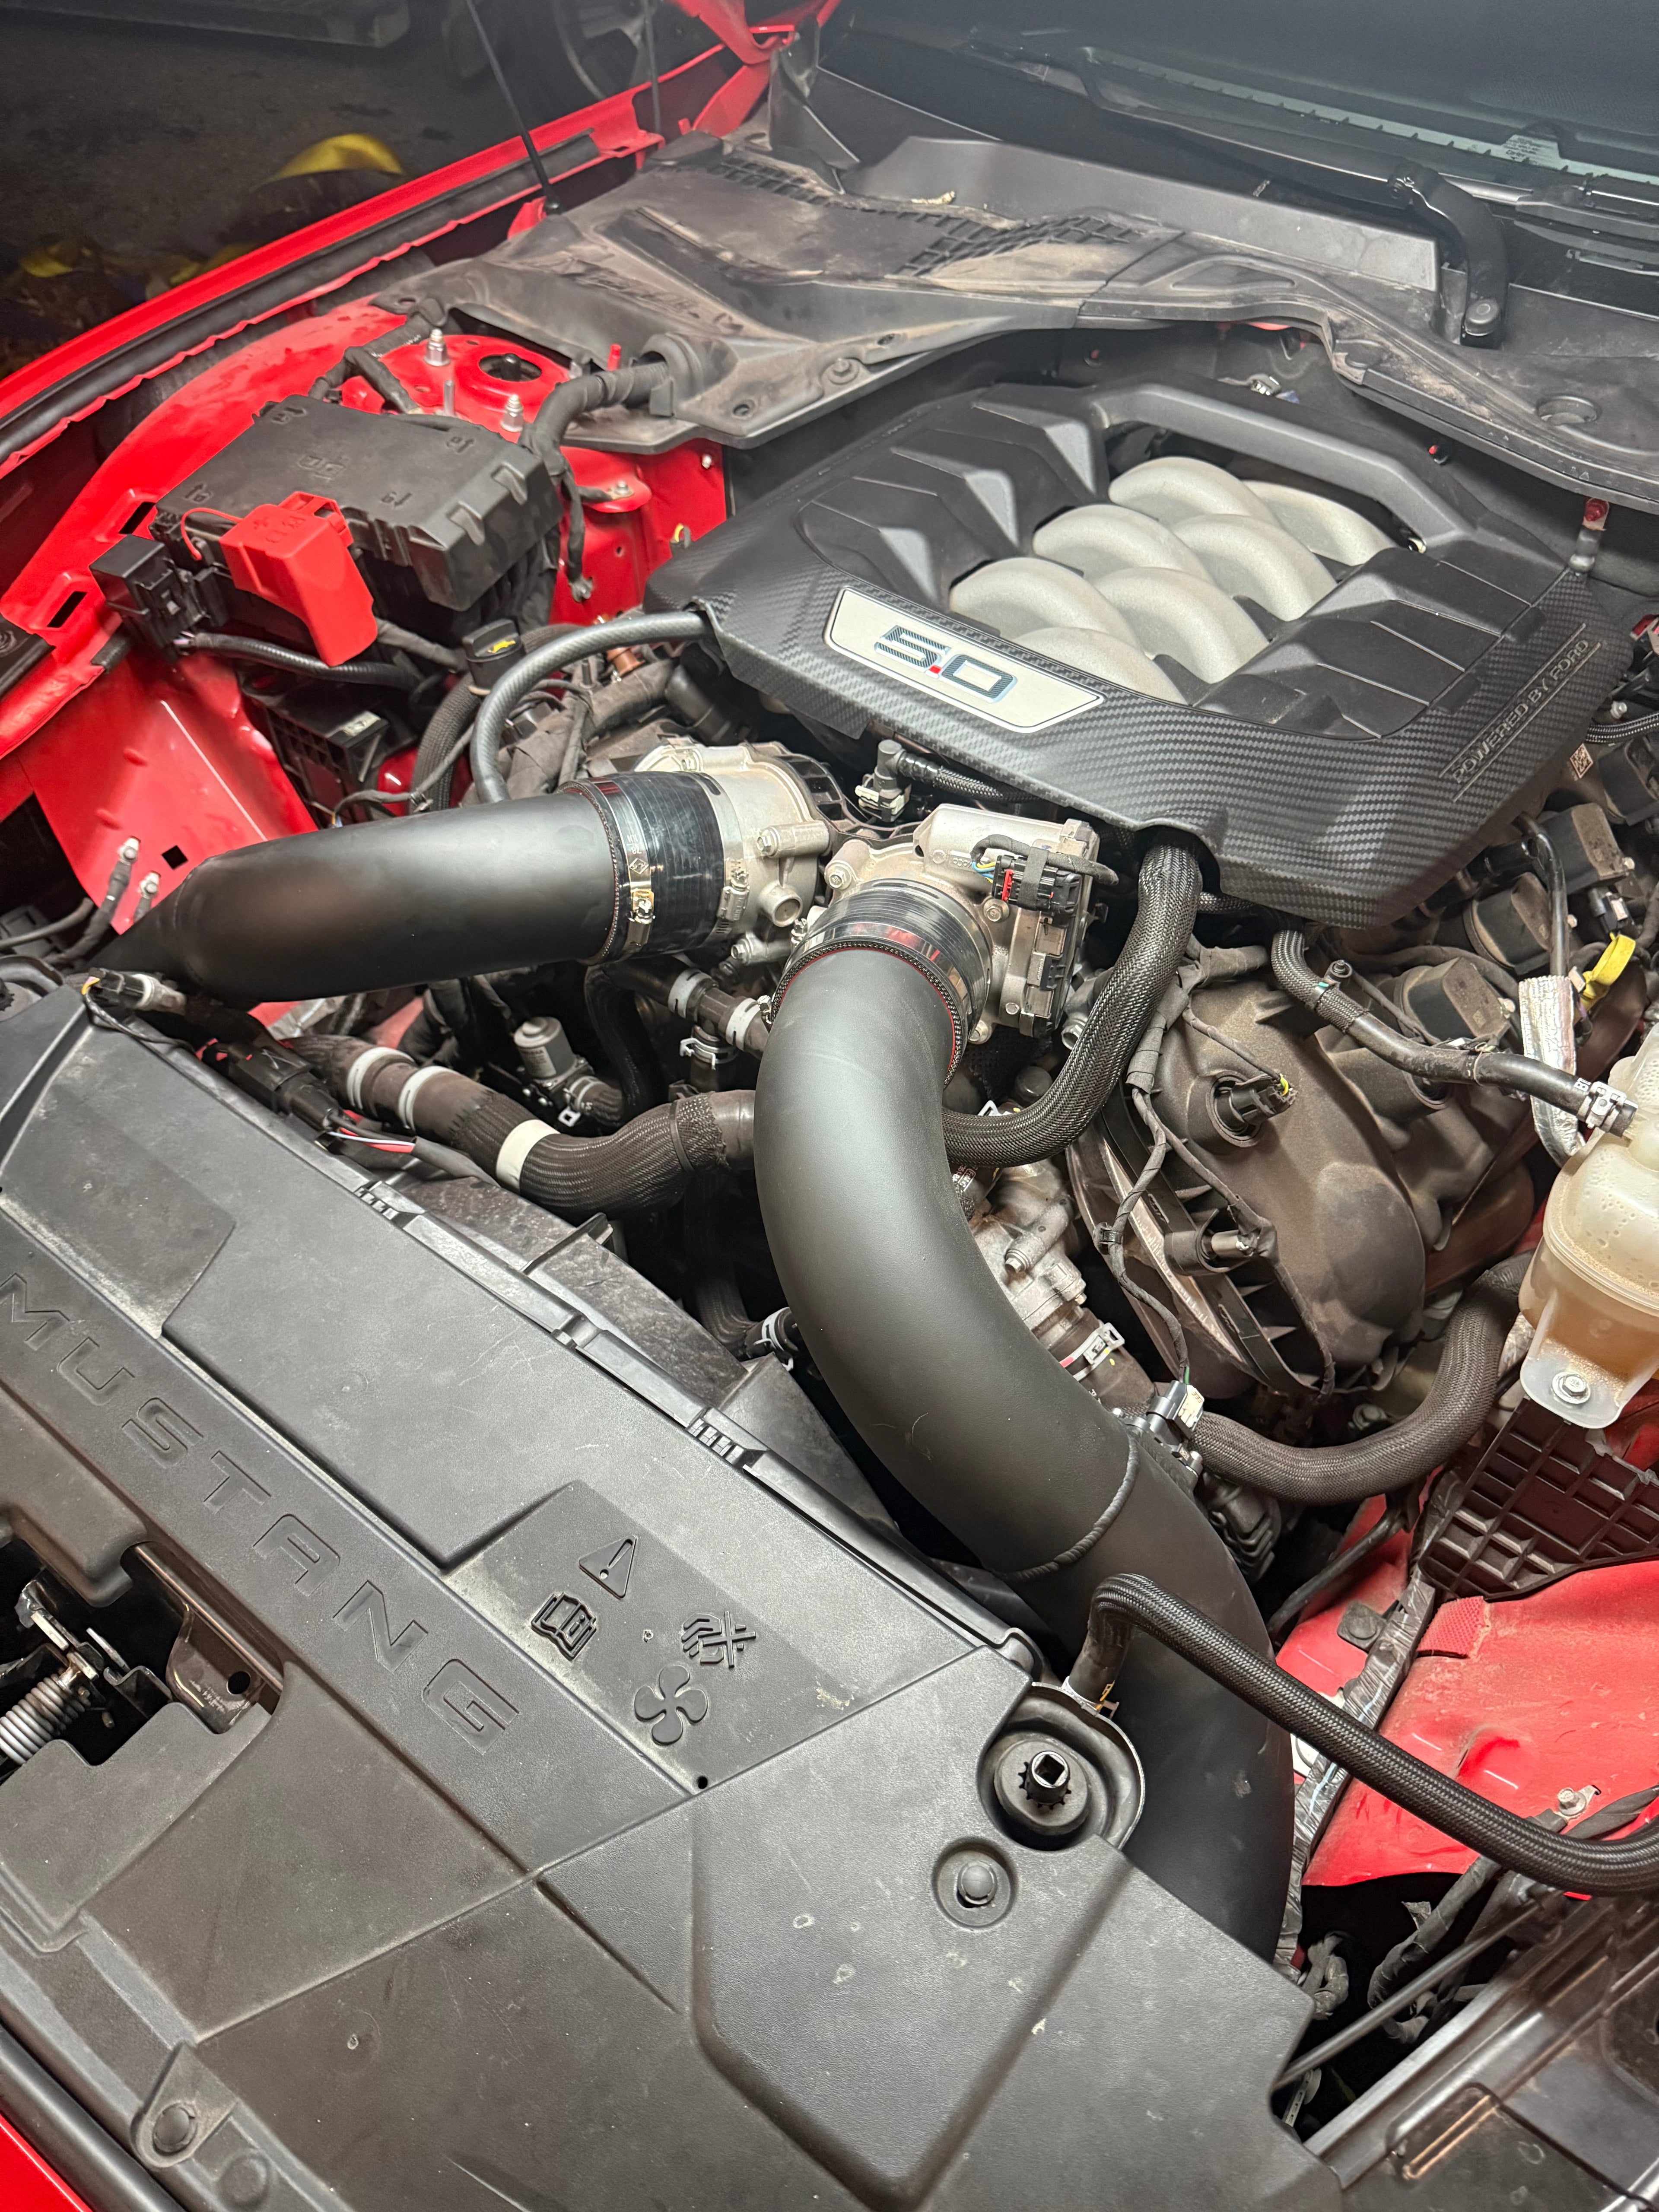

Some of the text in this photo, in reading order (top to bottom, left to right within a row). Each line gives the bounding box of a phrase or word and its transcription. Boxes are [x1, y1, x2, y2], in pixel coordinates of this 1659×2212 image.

[874, 625, 1018, 703] 5.0
[1452, 639, 1589, 784] POWERED BY FORD
[0, 1272, 521, 1756] MUSTANG
